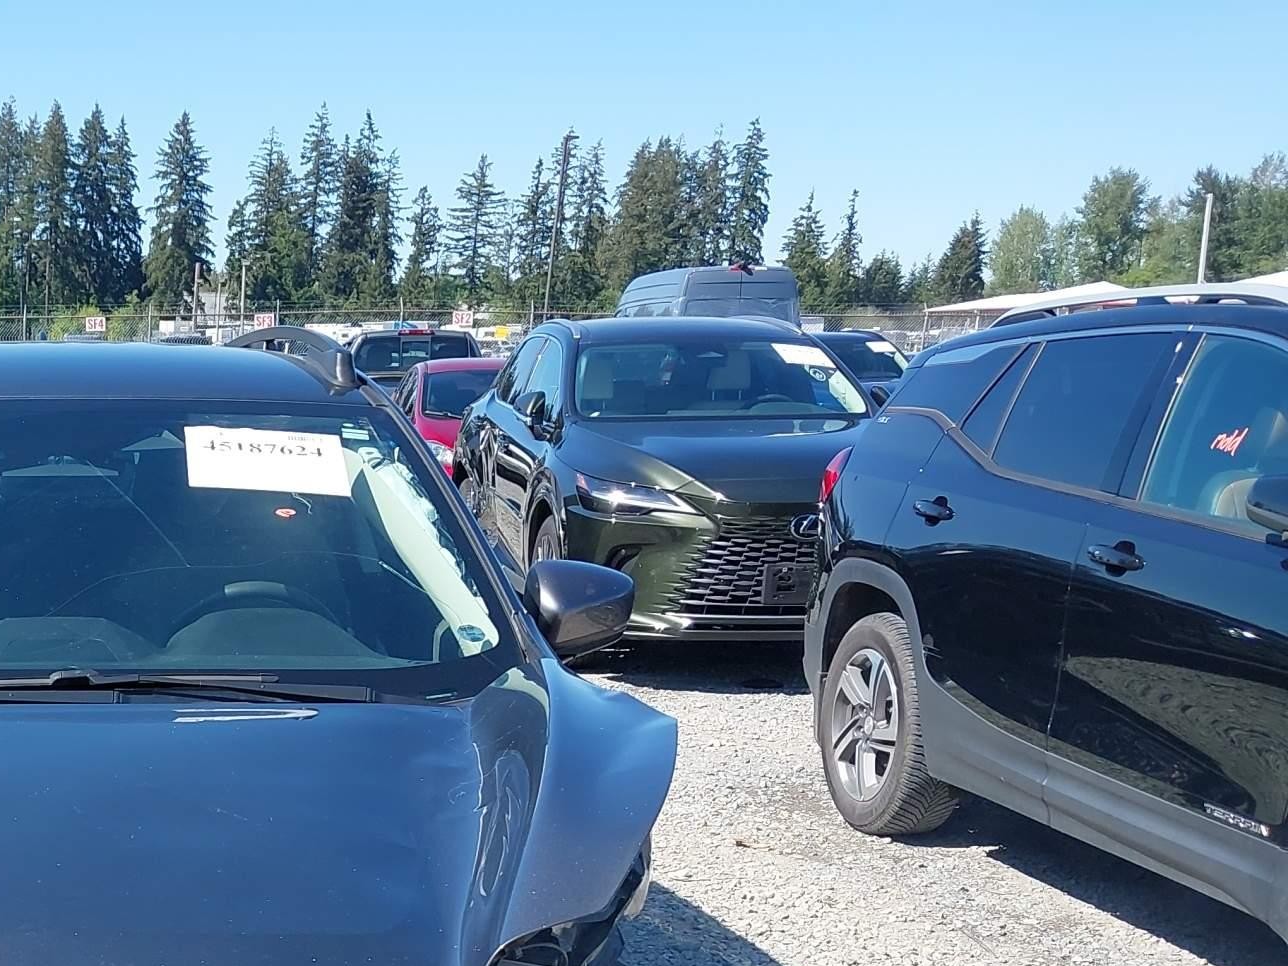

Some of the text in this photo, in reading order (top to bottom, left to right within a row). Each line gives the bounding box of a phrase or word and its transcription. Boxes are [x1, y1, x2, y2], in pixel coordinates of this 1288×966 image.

[87, 318, 104, 329] SF4
[255, 315, 272, 327] SF3
[454, 312, 472, 324] SF2
[201, 439, 323, 457] 45187624
